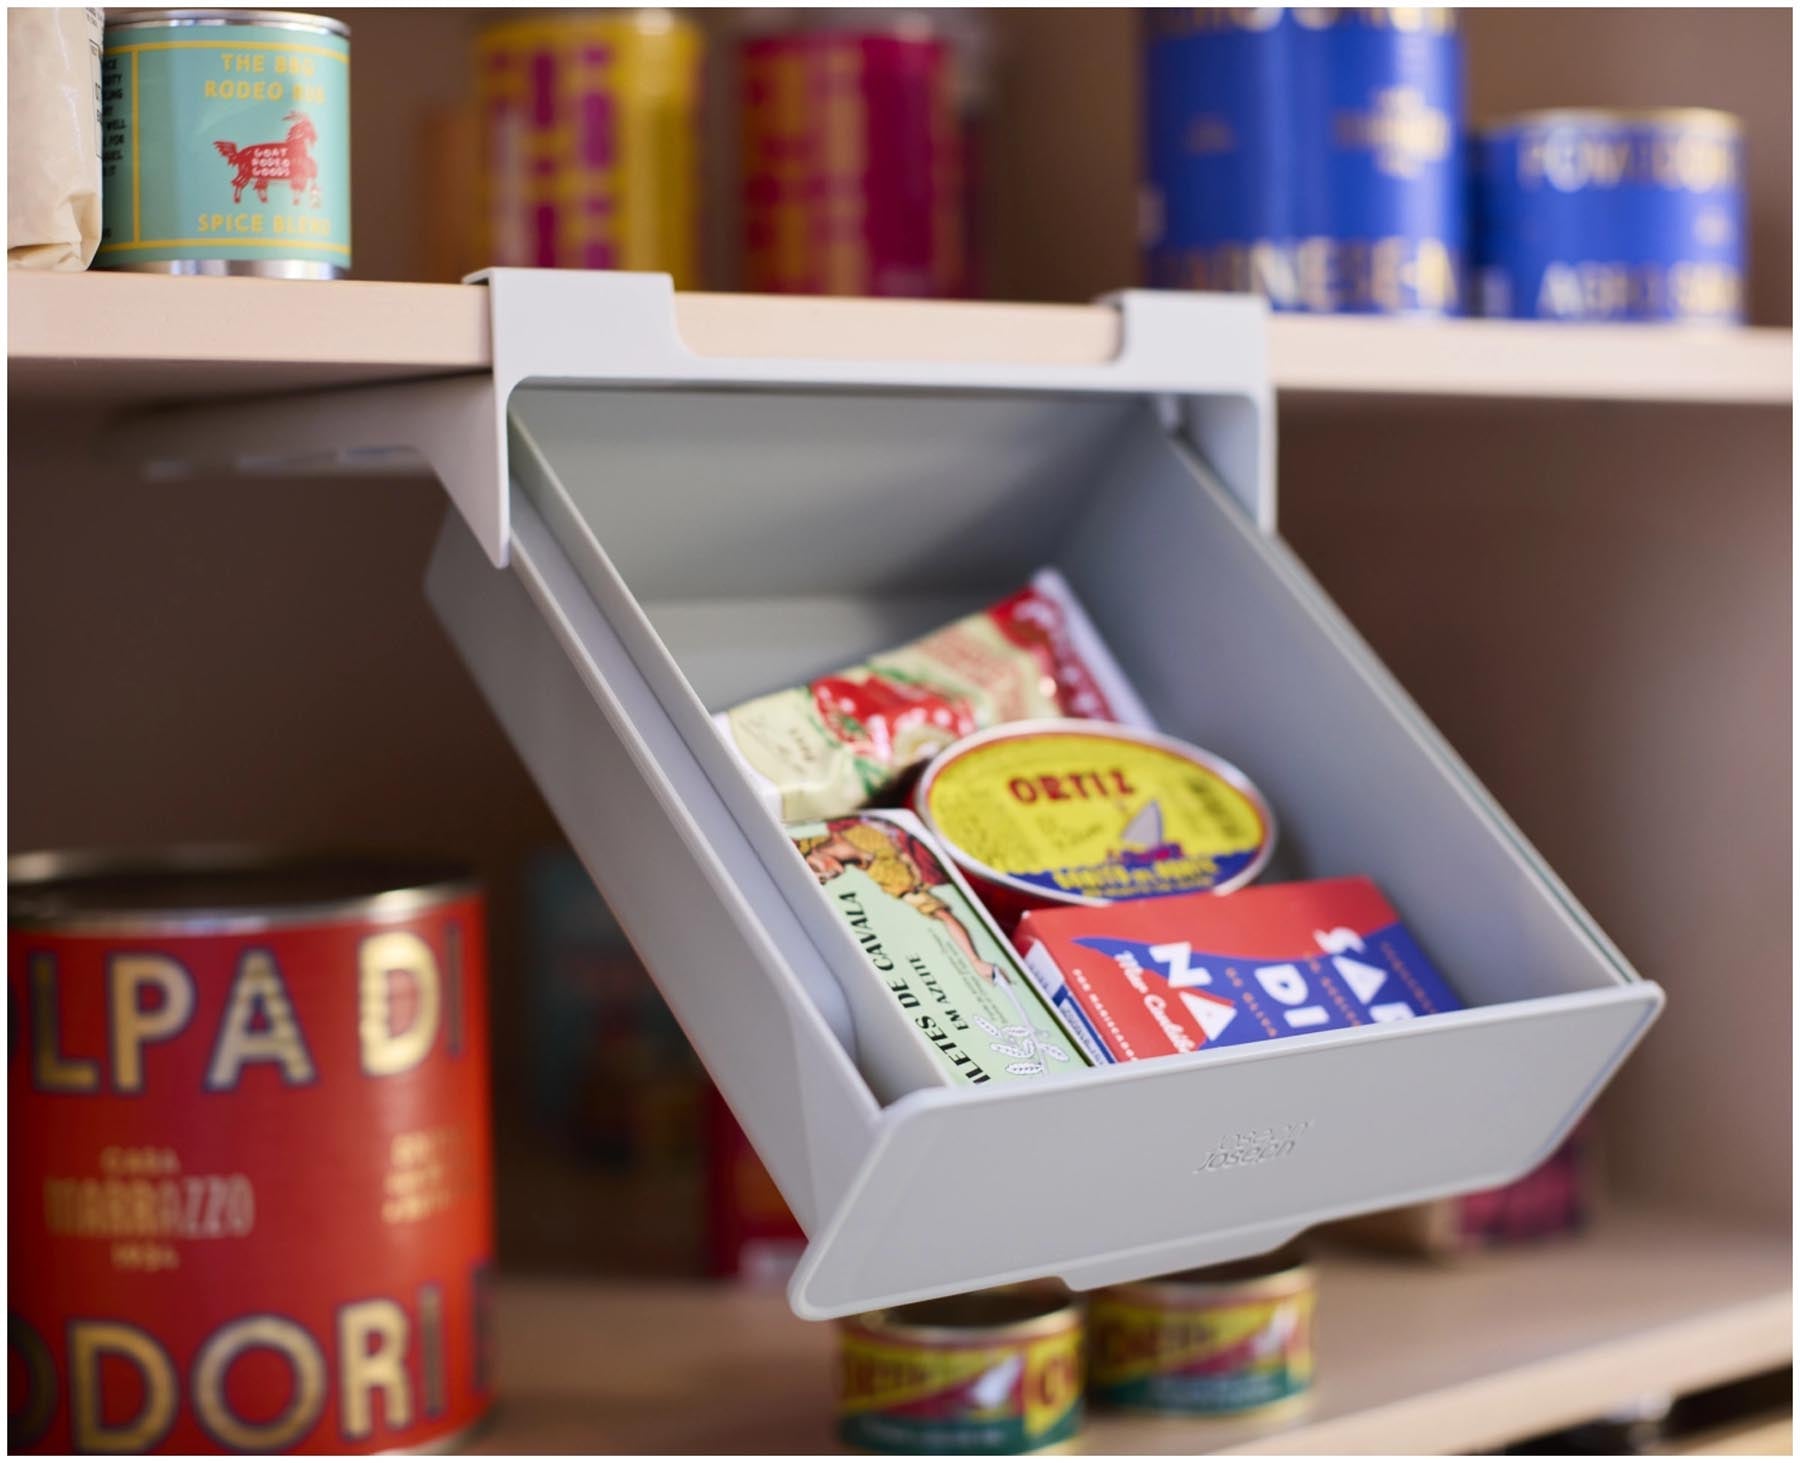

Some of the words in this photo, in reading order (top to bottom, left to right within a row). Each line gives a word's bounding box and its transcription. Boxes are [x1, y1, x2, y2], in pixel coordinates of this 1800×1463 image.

[221, 54, 264, 72] THE
[205, 80, 284, 101] RODEO
[198, 214, 264, 233] SPICE
[1008, 768, 1135, 804] ORTIZ
[838, 891, 894, 971] CAVALA
[888, 976, 921, 1009] DE
[908, 955, 948, 1005] AZEITE
[1149, 941, 1238, 1041] NA
[1254, 963, 1330, 1028] DI
[9, 946, 318, 1093] LPA
[356, 921, 466, 1077] DI
[945, 1009, 970, 1032] EM
